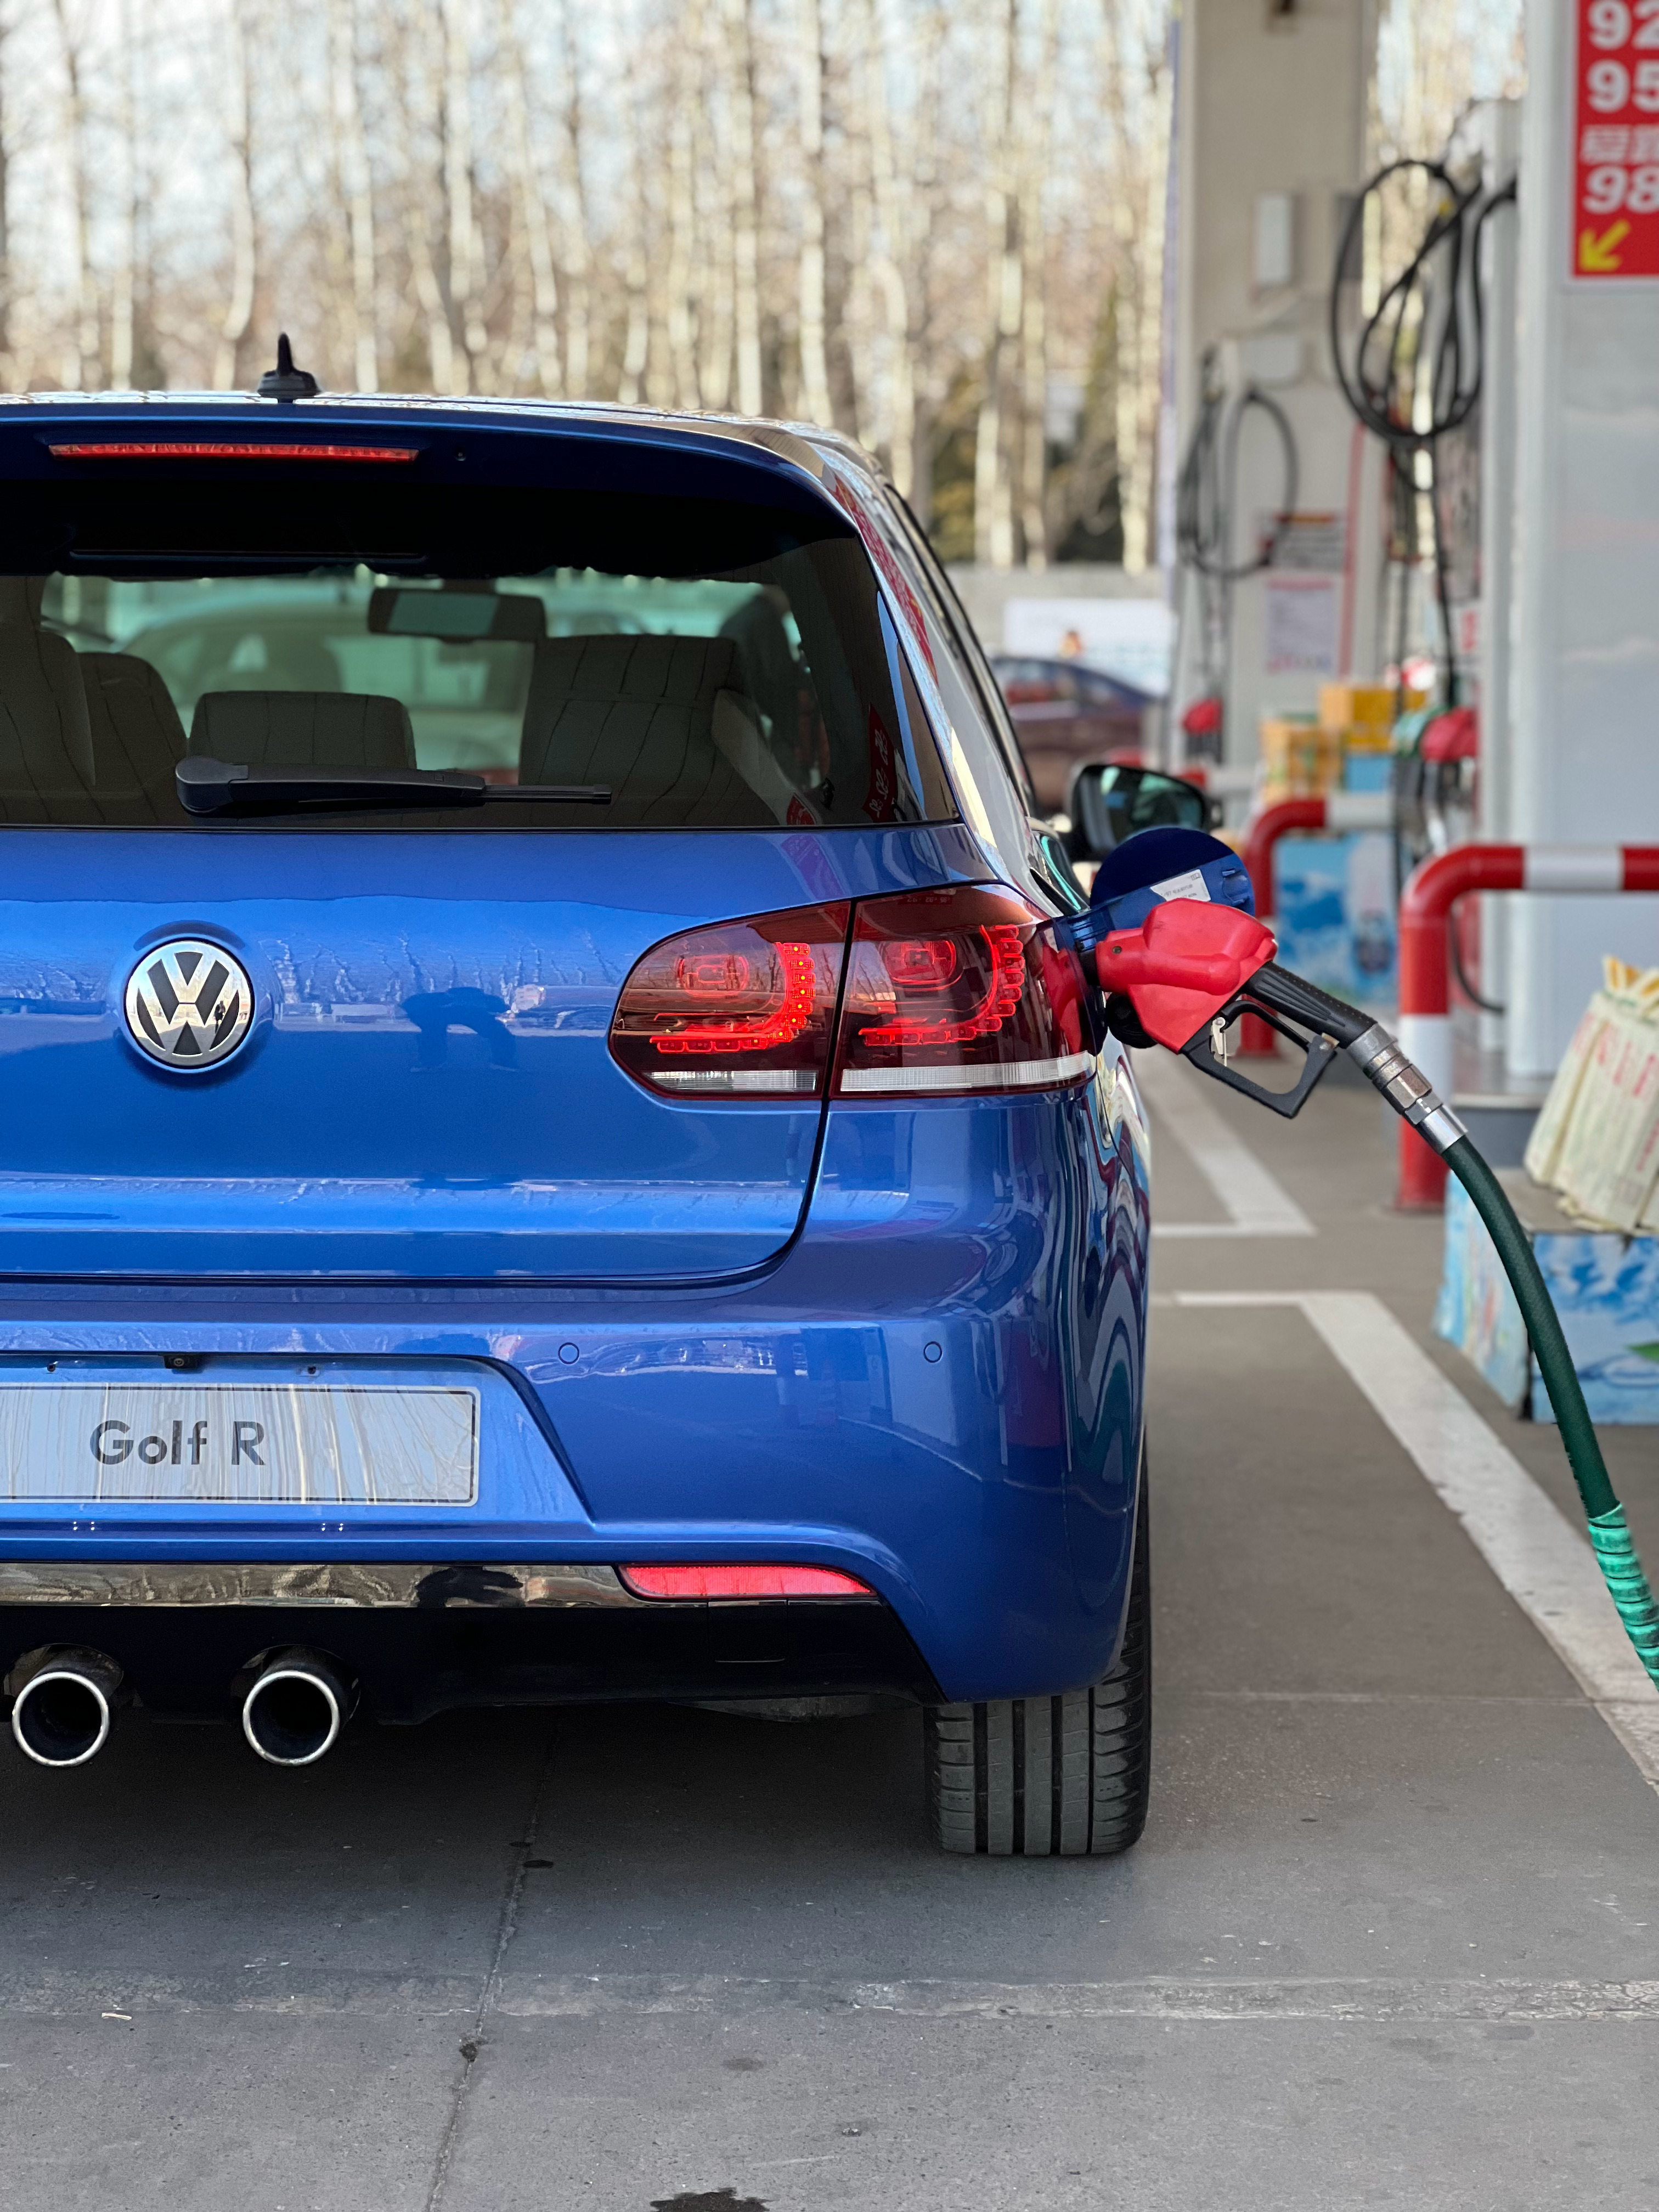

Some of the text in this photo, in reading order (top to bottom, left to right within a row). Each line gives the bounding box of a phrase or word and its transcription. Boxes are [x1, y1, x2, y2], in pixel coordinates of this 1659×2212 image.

[1589, 0, 1659, 49] 92
[1588, 58, 1659, 113] 95
[1583, 166, 1659, 214] 98
[126, 940, 251, 1065] VW
[89, 1420, 266, 1465] Golf R
